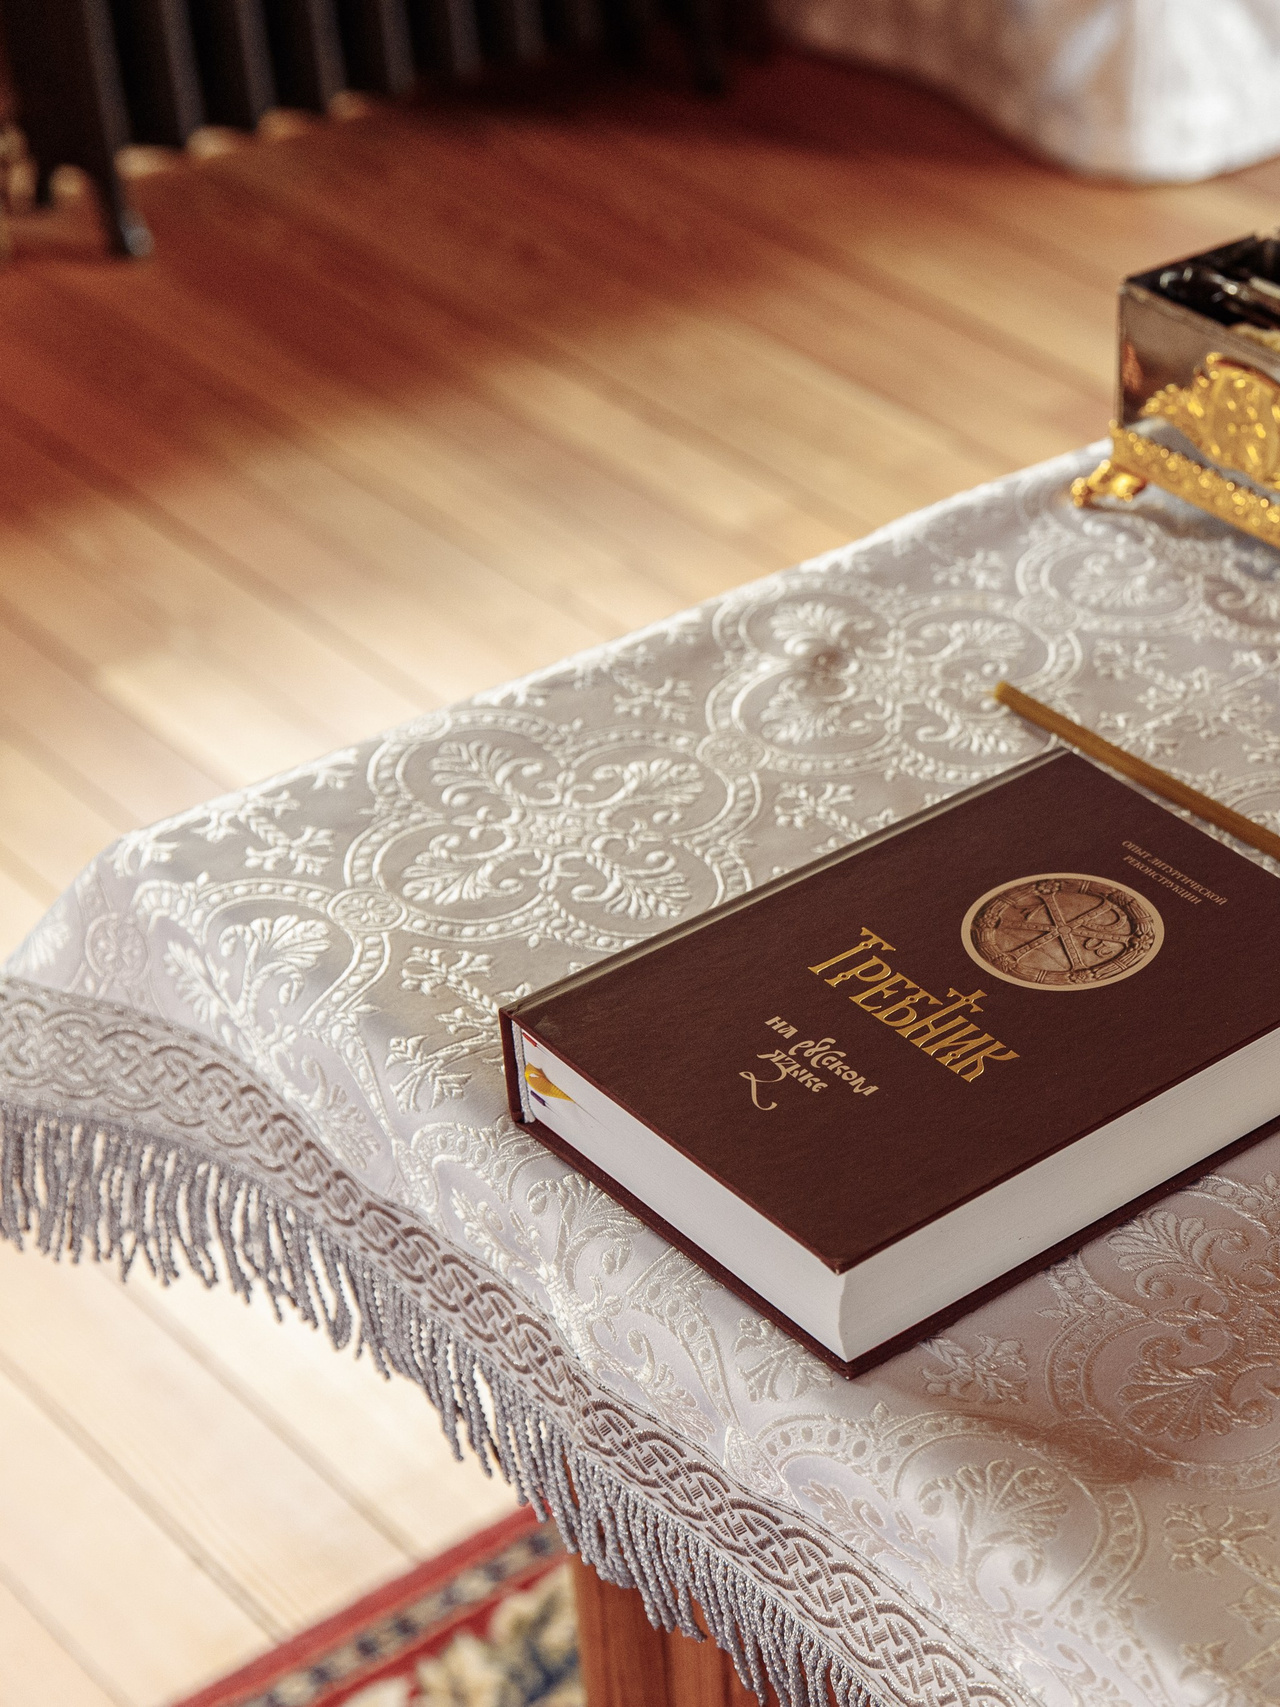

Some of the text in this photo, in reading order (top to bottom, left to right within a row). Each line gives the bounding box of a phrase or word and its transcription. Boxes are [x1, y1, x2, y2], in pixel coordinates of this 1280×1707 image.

[1122, 840, 1228, 906] ОПЫТ ЛИТУРГИЧЕСКОЙ
[1123, 855, 1202, 905] РЕКОНСТРУКЦИИ
